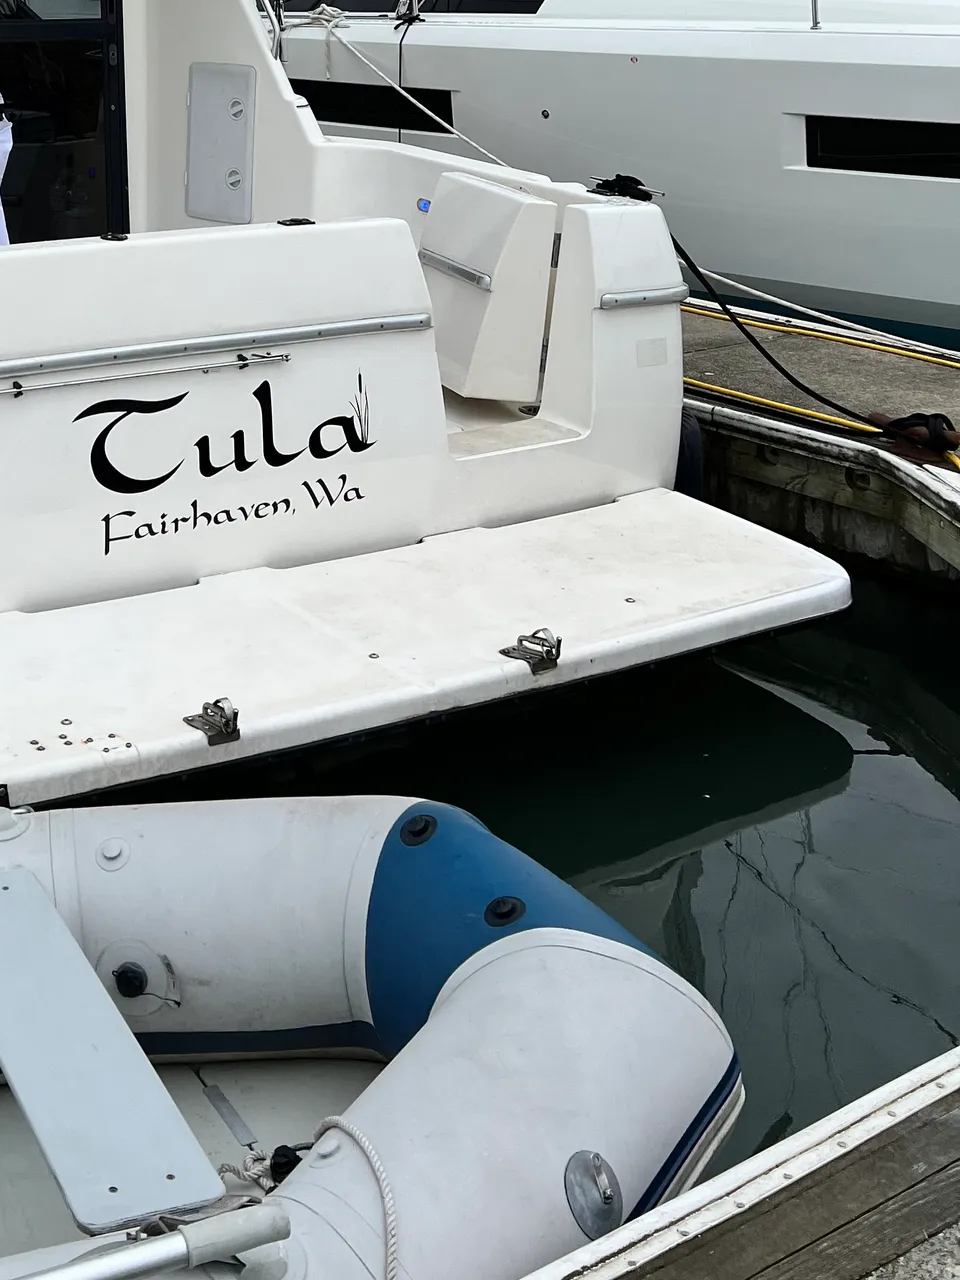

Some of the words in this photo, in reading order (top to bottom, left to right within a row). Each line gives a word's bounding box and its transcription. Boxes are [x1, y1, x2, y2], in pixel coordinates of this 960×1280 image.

[72, 379, 378, 494] Tula
[100, 499, 296, 556] Fairhaven,
[301, 473, 366, 510] Wa
